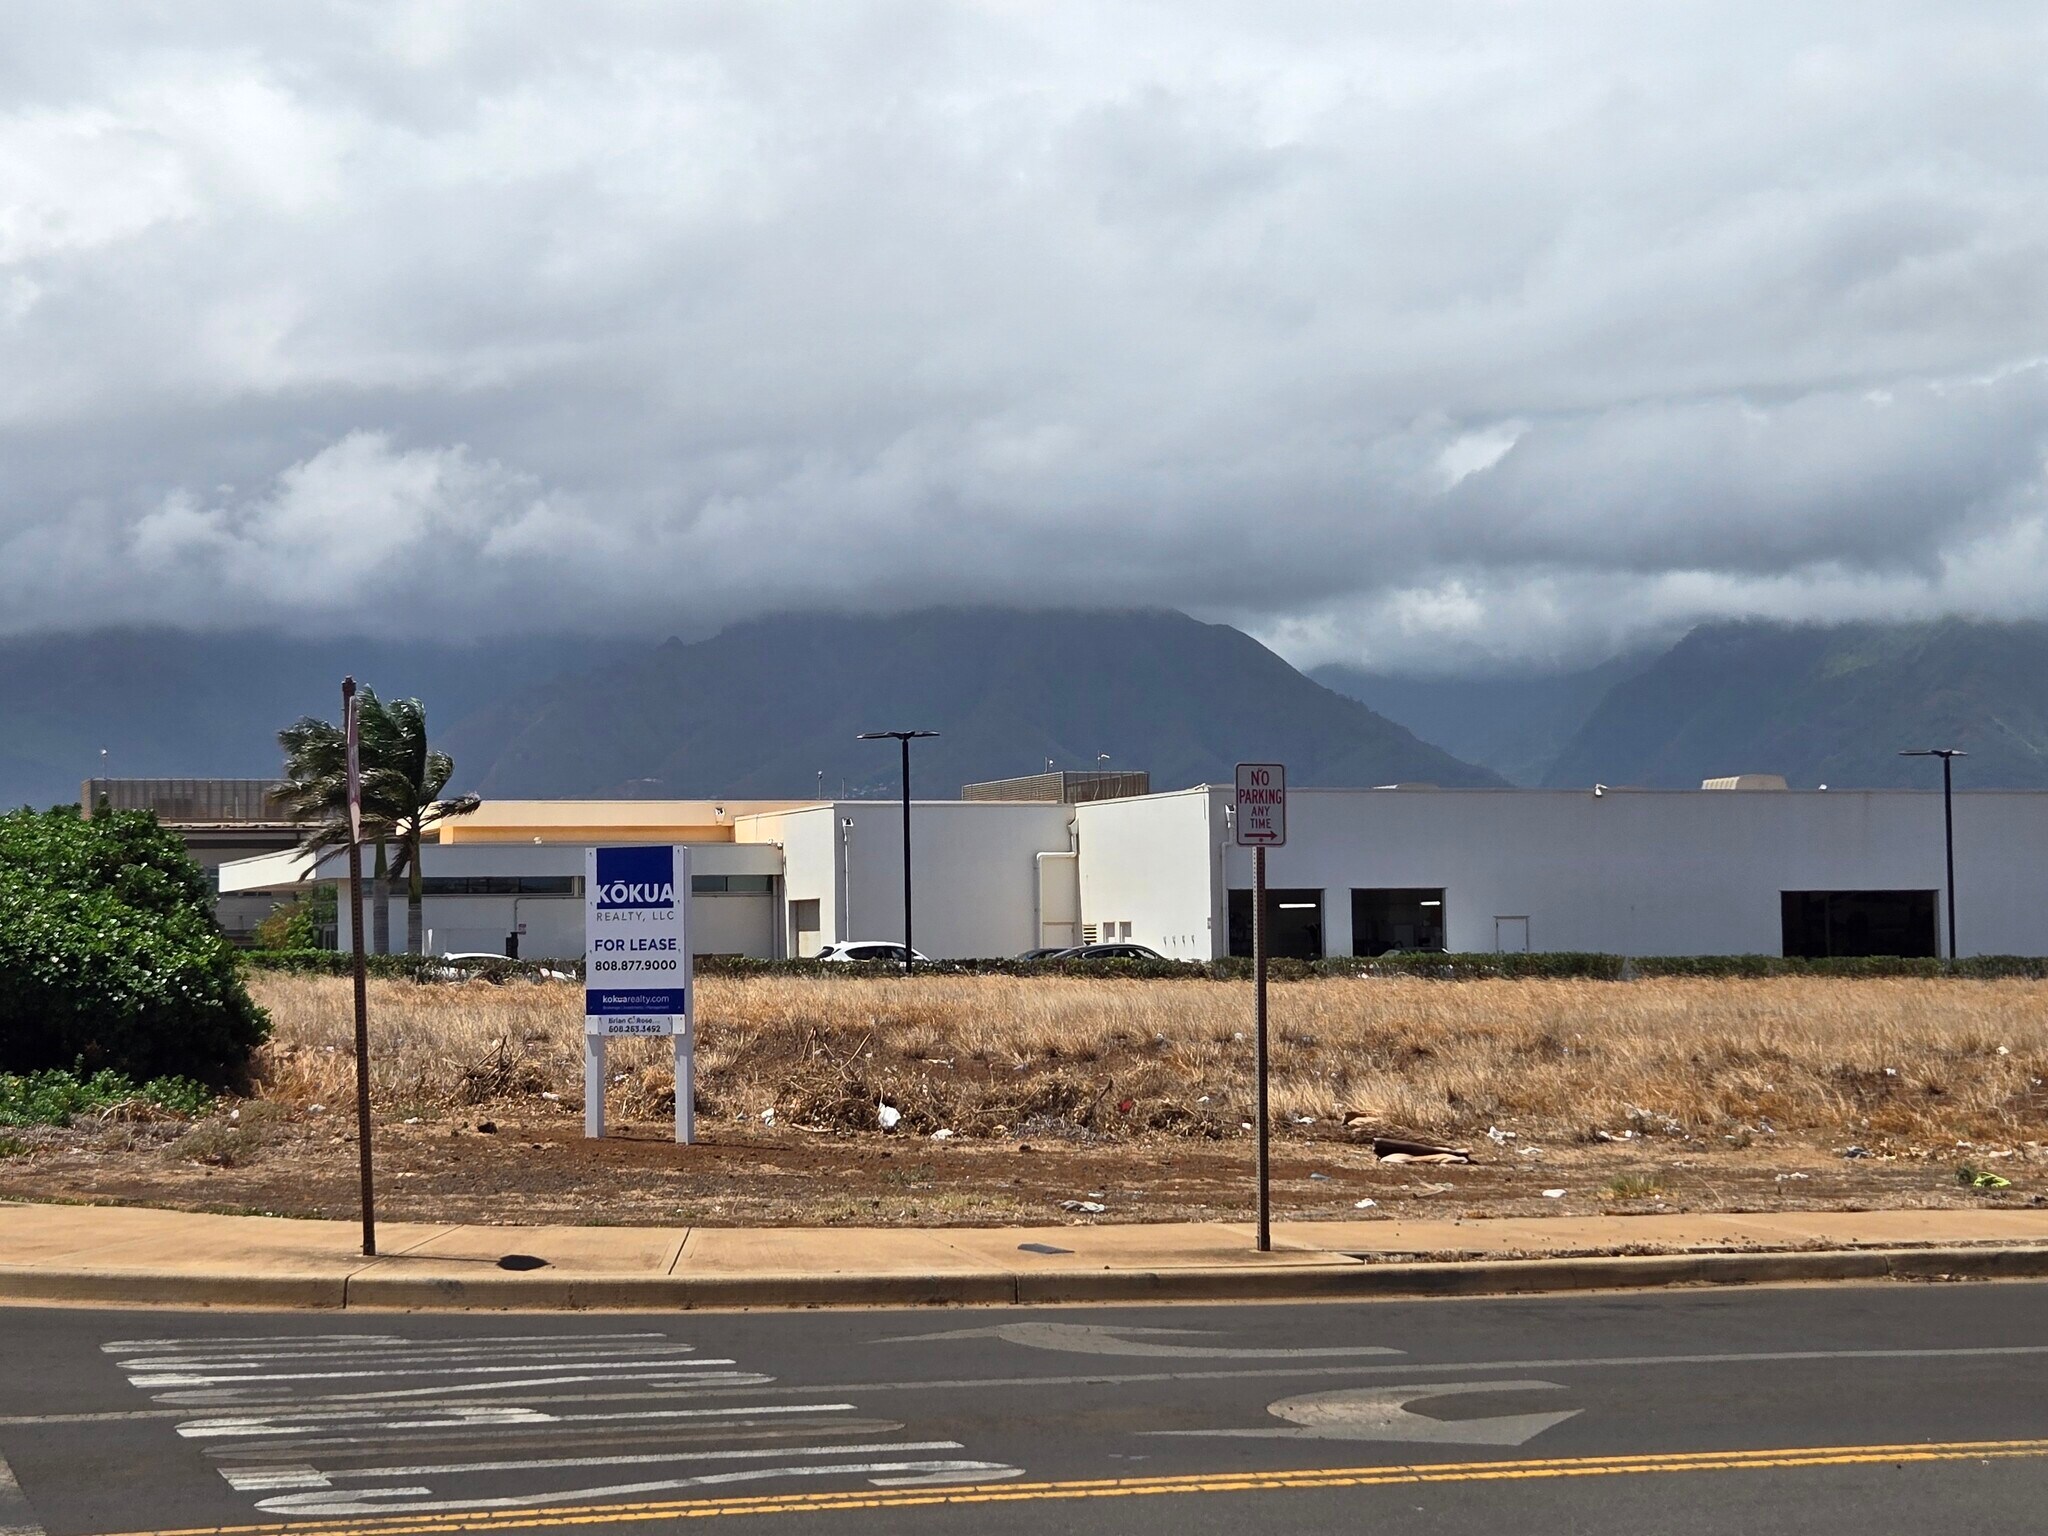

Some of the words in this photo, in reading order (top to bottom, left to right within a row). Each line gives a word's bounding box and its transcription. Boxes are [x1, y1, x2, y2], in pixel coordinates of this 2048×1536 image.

[1251, 770, 1269, 786] NO
[1239, 788, 1282, 804] PARKING
[1251, 805, 1270, 817] ANY
[1250, 818, 1271, 829] TIME
[597, 880, 674, 904] KŌKUA
[597, 911, 646, 922] REALTY,
[652, 911, 674, 921] LLC
[595, 939, 625, 951] FOR
[630, 938, 677, 951] LEASE
[595, 960, 677, 971] 808.877.9000
[602, 994, 670, 1004] kokuarealty.com
[100, 1333, 777, 1404] STOP
[174, 1405, 1027, 1515] STOP
